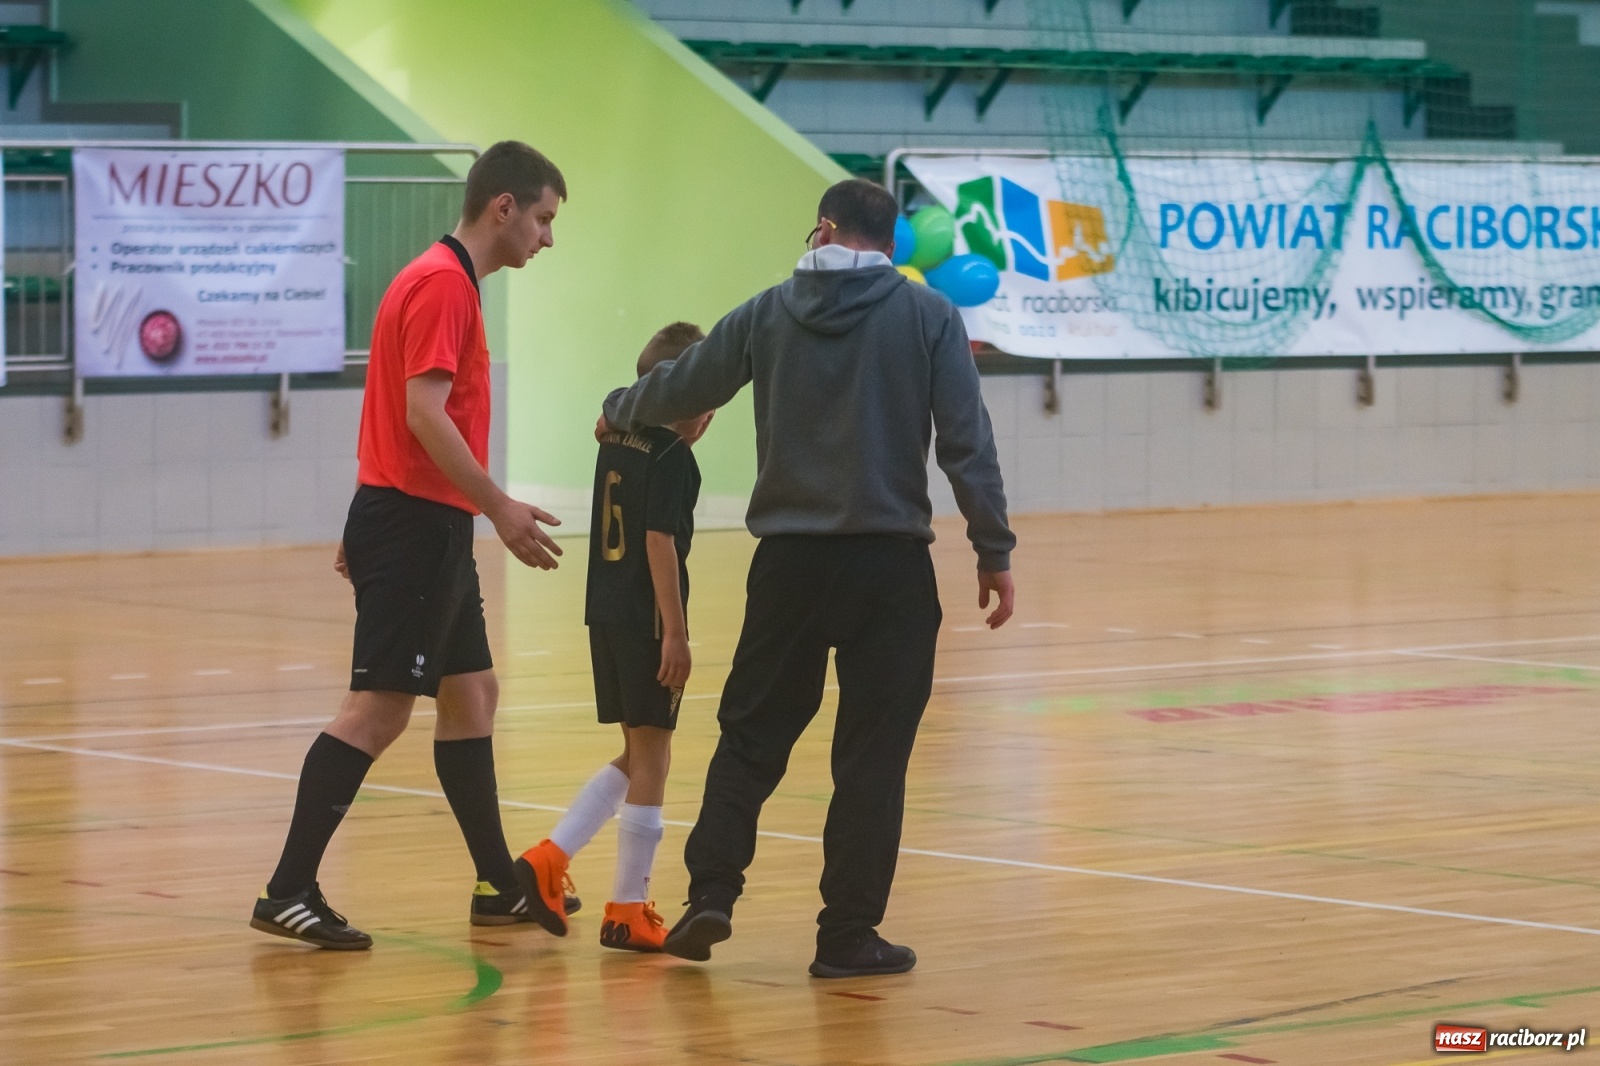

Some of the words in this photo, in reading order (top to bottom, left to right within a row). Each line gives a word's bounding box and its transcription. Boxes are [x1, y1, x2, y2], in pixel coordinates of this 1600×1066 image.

[109, 162, 312, 208] MIESZKO
[1160, 202, 1350, 250] POWIAT
[111, 243, 174, 258] Operator
[111, 261, 185, 274] Pracownik
[190, 262, 276, 276] produkcyjny
[198, 289, 260, 305] Czekamy
[264, 291, 280, 301] na
[283, 288, 327, 301] Ciebie!
[1153, 277, 1337, 320] kibicujemy,
[1356, 277, 1532, 320] wspieramy,
[602, 470, 625, 562] 6
